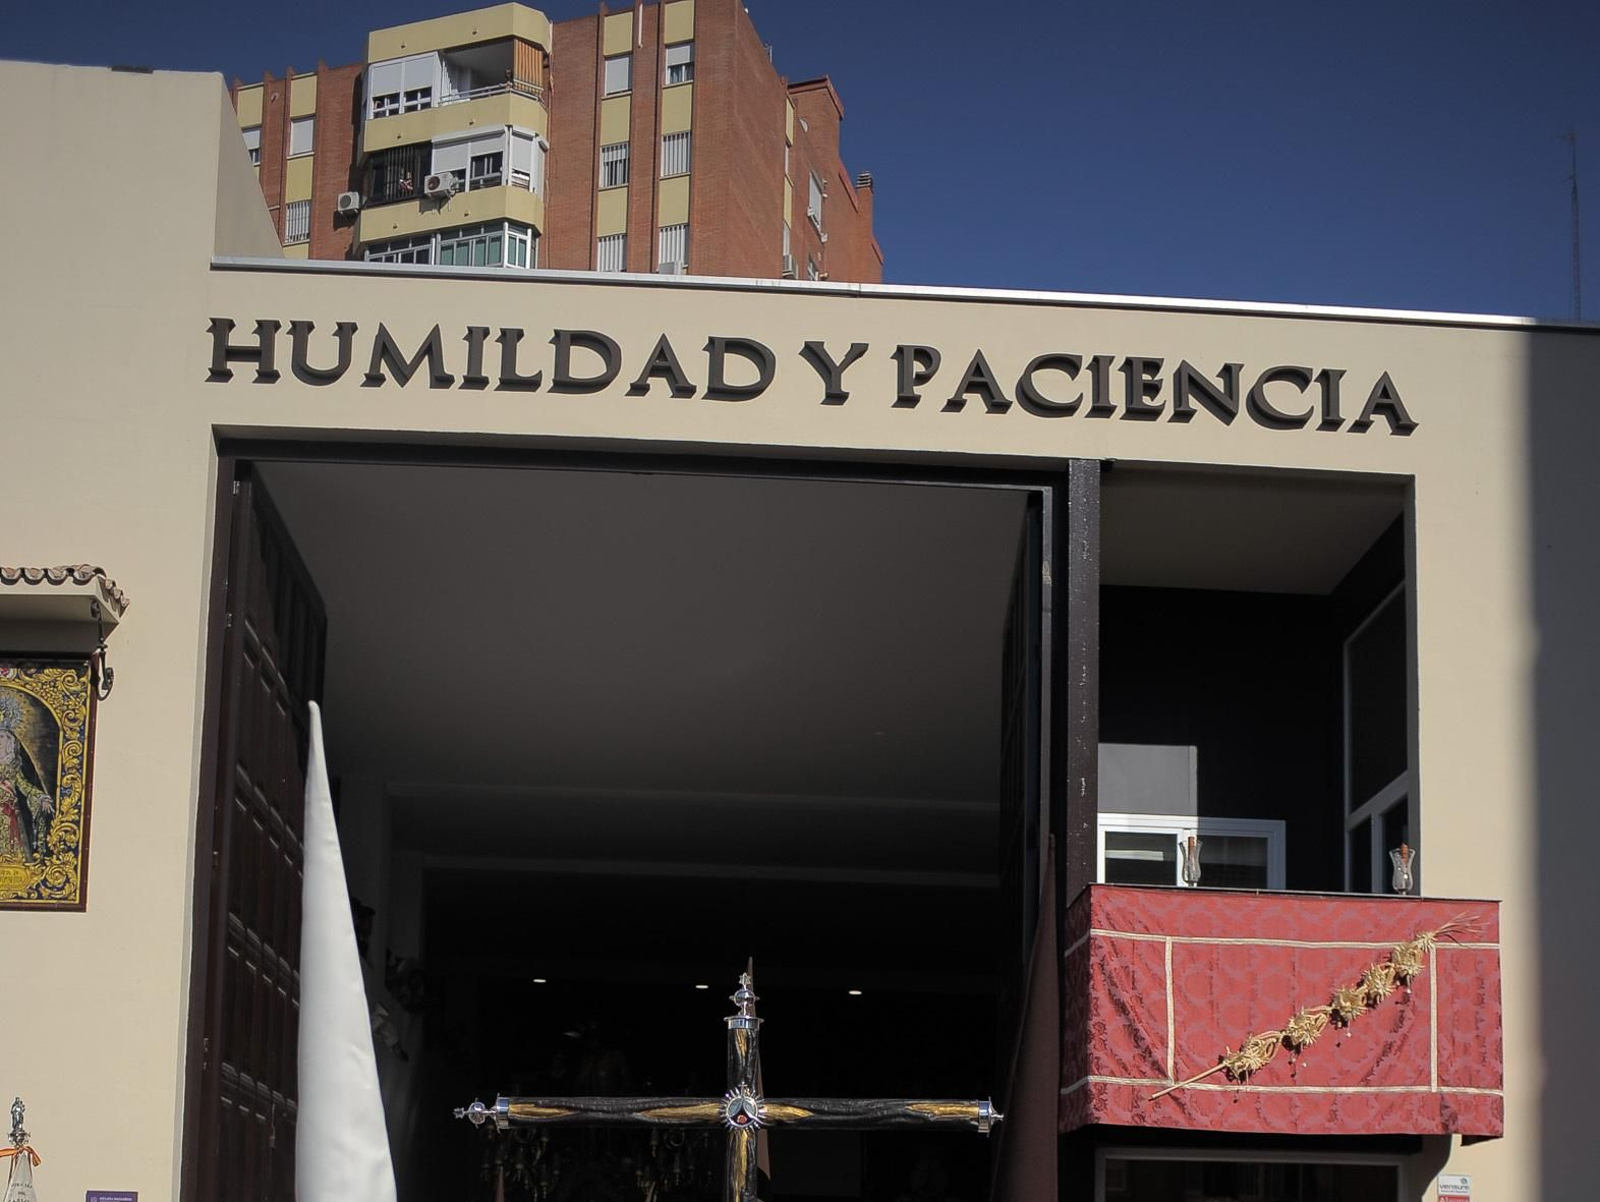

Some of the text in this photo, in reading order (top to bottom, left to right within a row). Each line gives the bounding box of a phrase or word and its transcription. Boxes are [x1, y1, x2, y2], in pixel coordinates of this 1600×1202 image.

[204, 317, 1419, 436] HUMILDAD Y PACIENCIA
